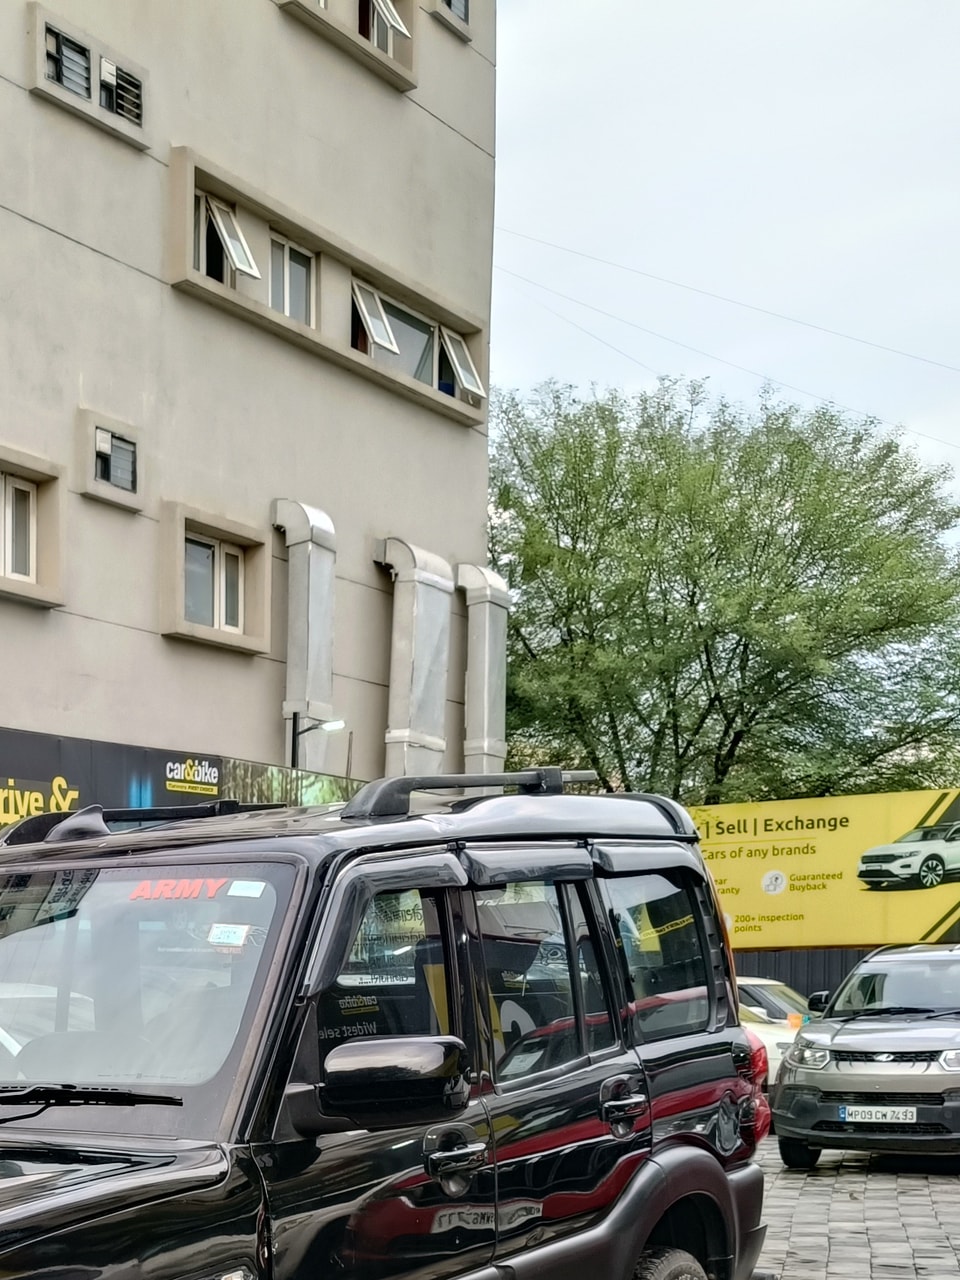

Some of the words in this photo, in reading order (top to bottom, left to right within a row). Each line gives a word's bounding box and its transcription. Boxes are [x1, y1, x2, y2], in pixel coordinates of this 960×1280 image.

[166, 759, 218, 784] car&bike
[715, 819, 748, 835] Sell
[763, 815, 850, 834] Exchange
[729, 847, 744, 858] of
[746, 848, 769, 860] any
[772, 844, 817, 857] brands
[789, 871, 843, 882] Guaranteed
[128, 877, 229, 901] ARMY
[789, 882, 827, 893] Buyback
[734, 914, 756, 924] 200+
[757, 913, 805, 923] inspection
[734, 924, 763, 934] points
